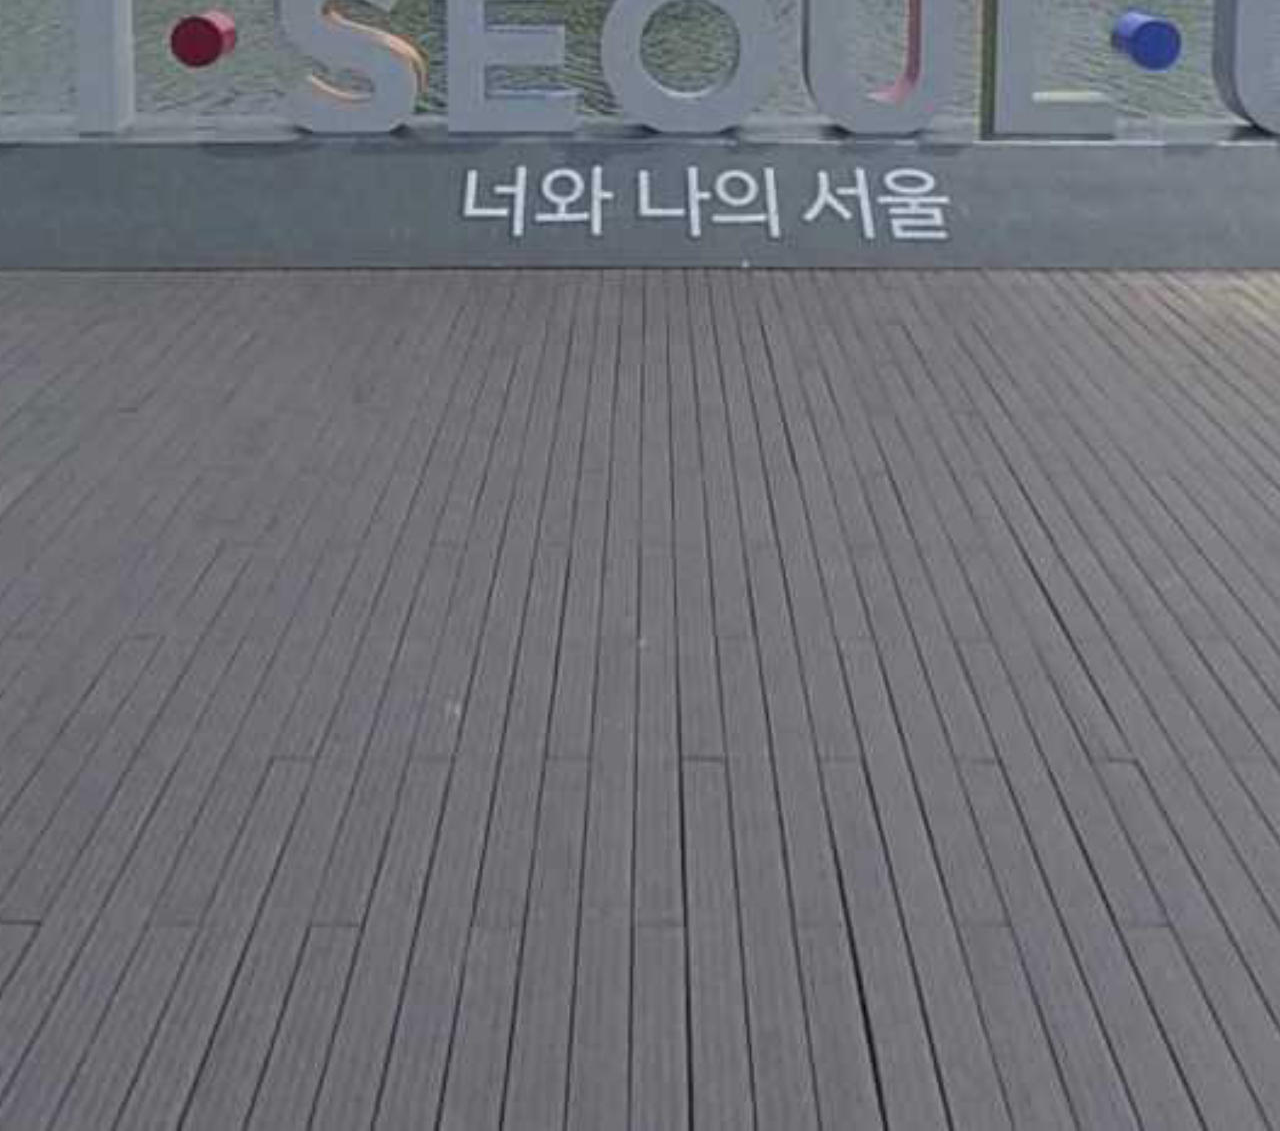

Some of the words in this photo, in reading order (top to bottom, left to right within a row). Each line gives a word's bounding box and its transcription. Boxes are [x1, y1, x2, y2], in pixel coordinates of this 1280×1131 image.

[463, 166, 614, 236] 너와
[638, 167, 781, 237] 나의
[804, 167, 950, 239] 서울
